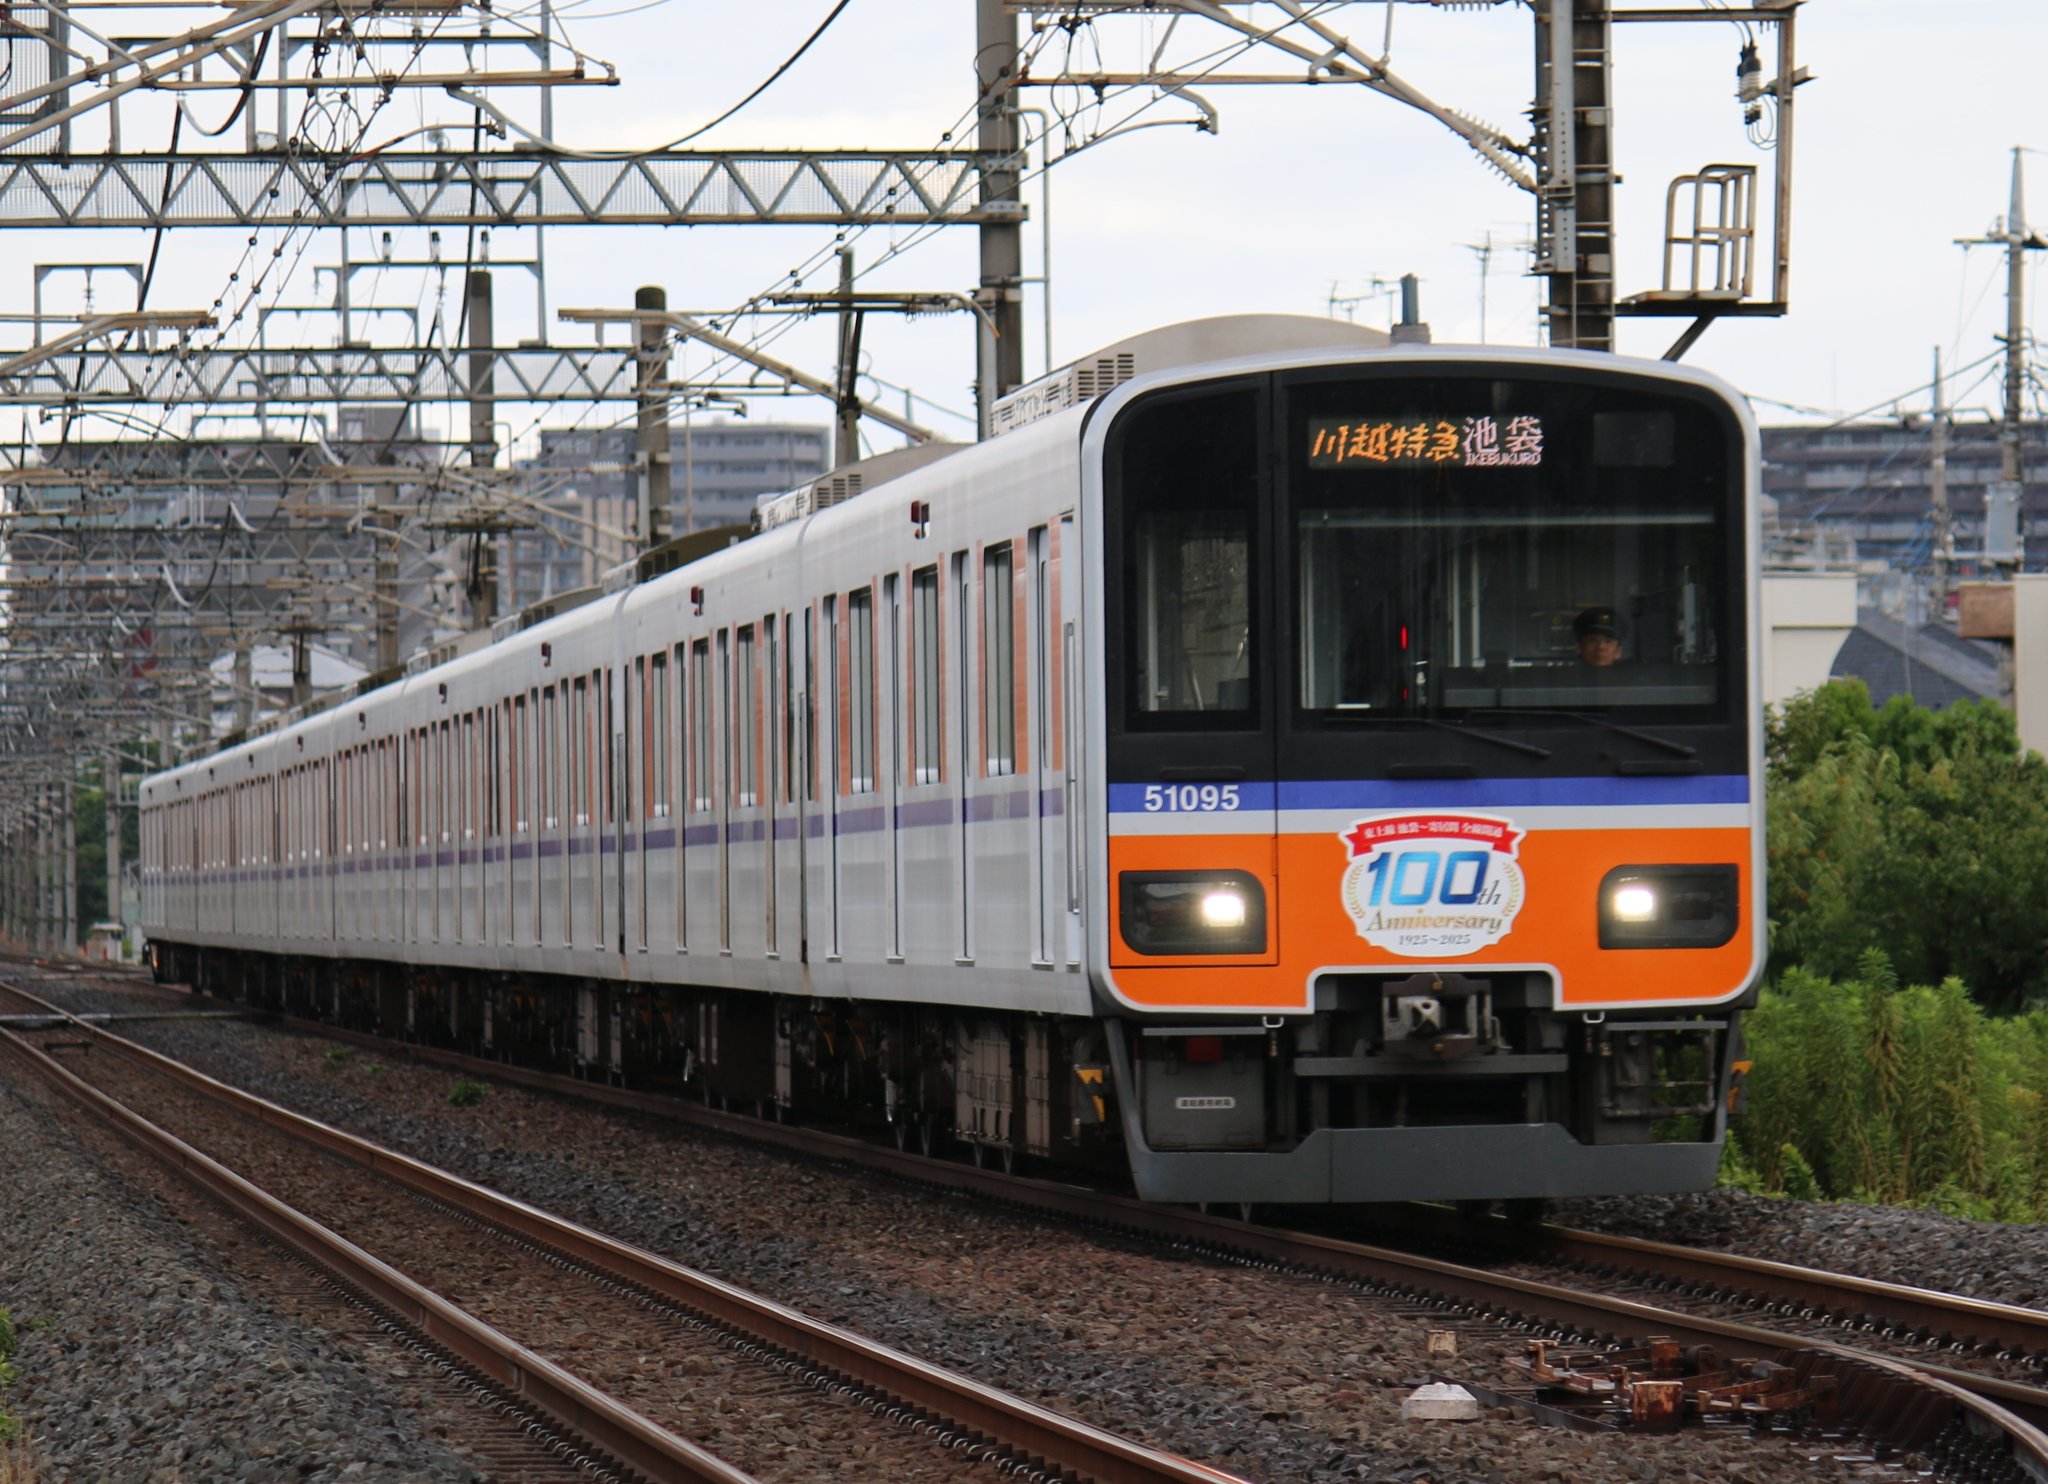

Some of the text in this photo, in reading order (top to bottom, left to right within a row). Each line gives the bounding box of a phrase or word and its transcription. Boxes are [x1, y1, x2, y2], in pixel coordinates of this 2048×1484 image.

[1312, 416, 1544, 463] 川越特急 池袋
[1464, 452, 1542, 467] IKEBUKURO
[1144, 785, 1240, 811] 51095
[1365, 908, 1503, 935] Anniversary
